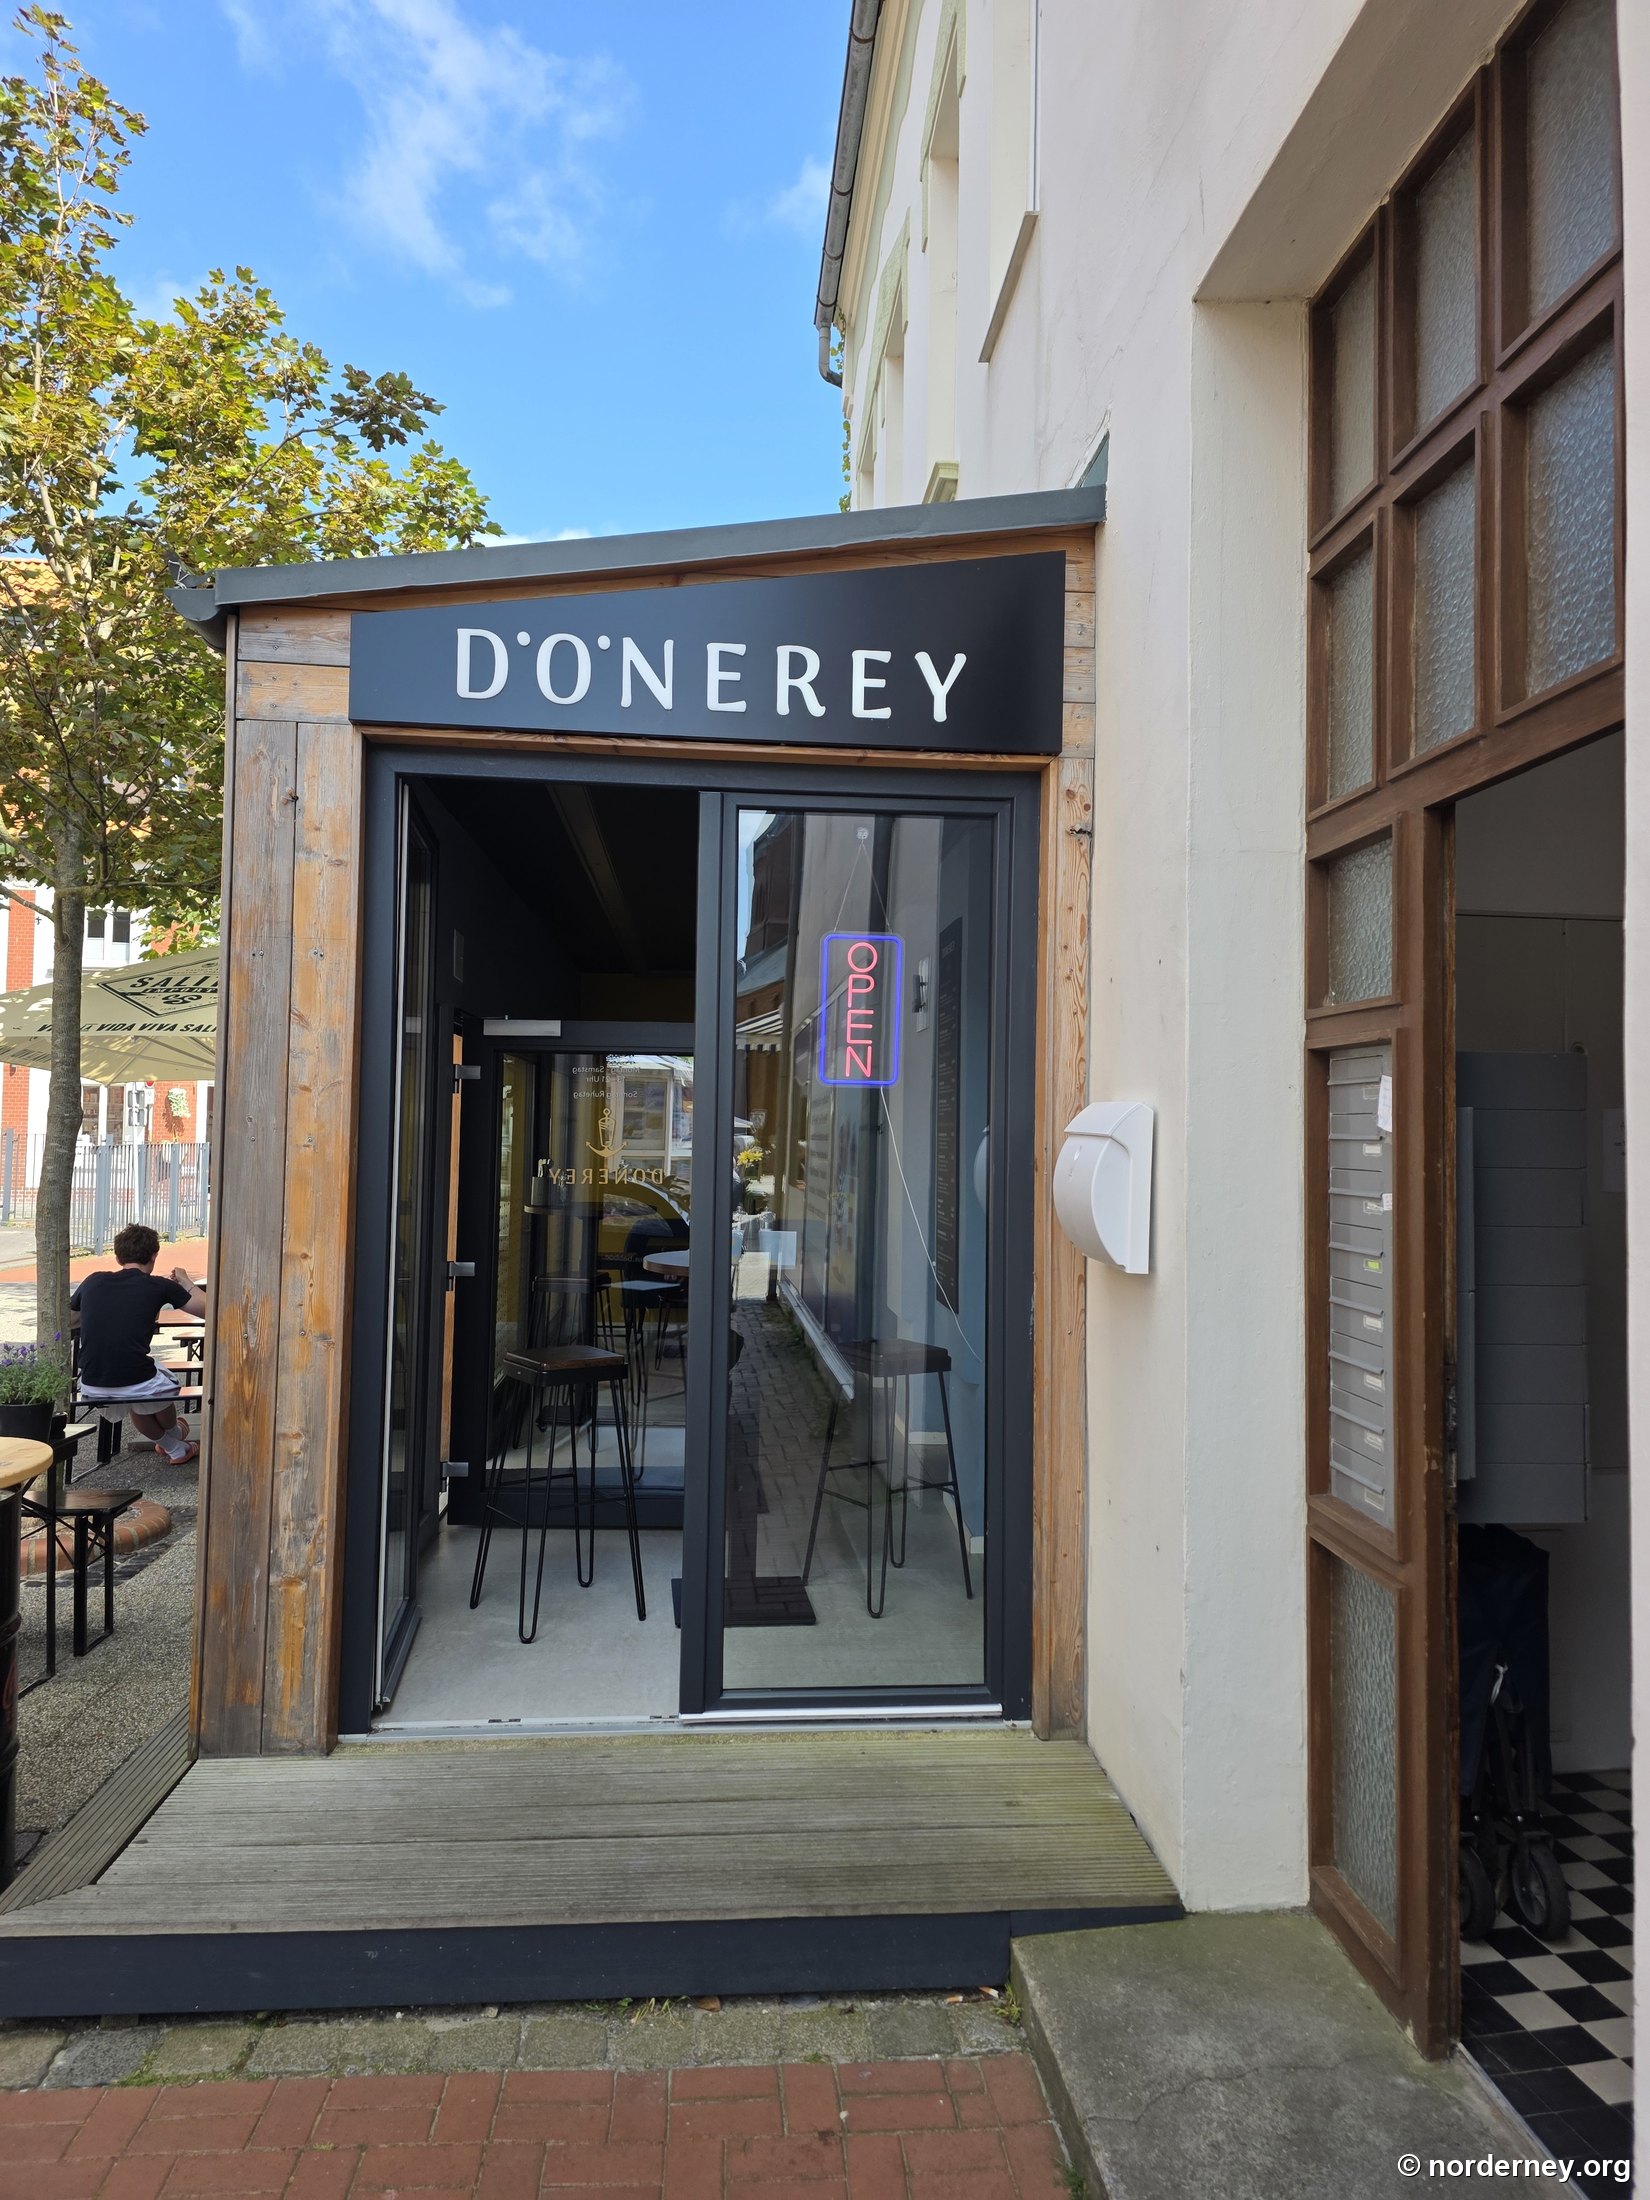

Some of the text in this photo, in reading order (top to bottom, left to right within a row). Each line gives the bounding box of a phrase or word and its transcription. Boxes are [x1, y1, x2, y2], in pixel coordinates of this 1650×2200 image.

[96, 1023, 137, 1032] VIDA
[138, 1023, 178, 1032] VIVA
[180, 1023, 218, 1033] SALI
[845, 941, 878, 1078] OPEN
